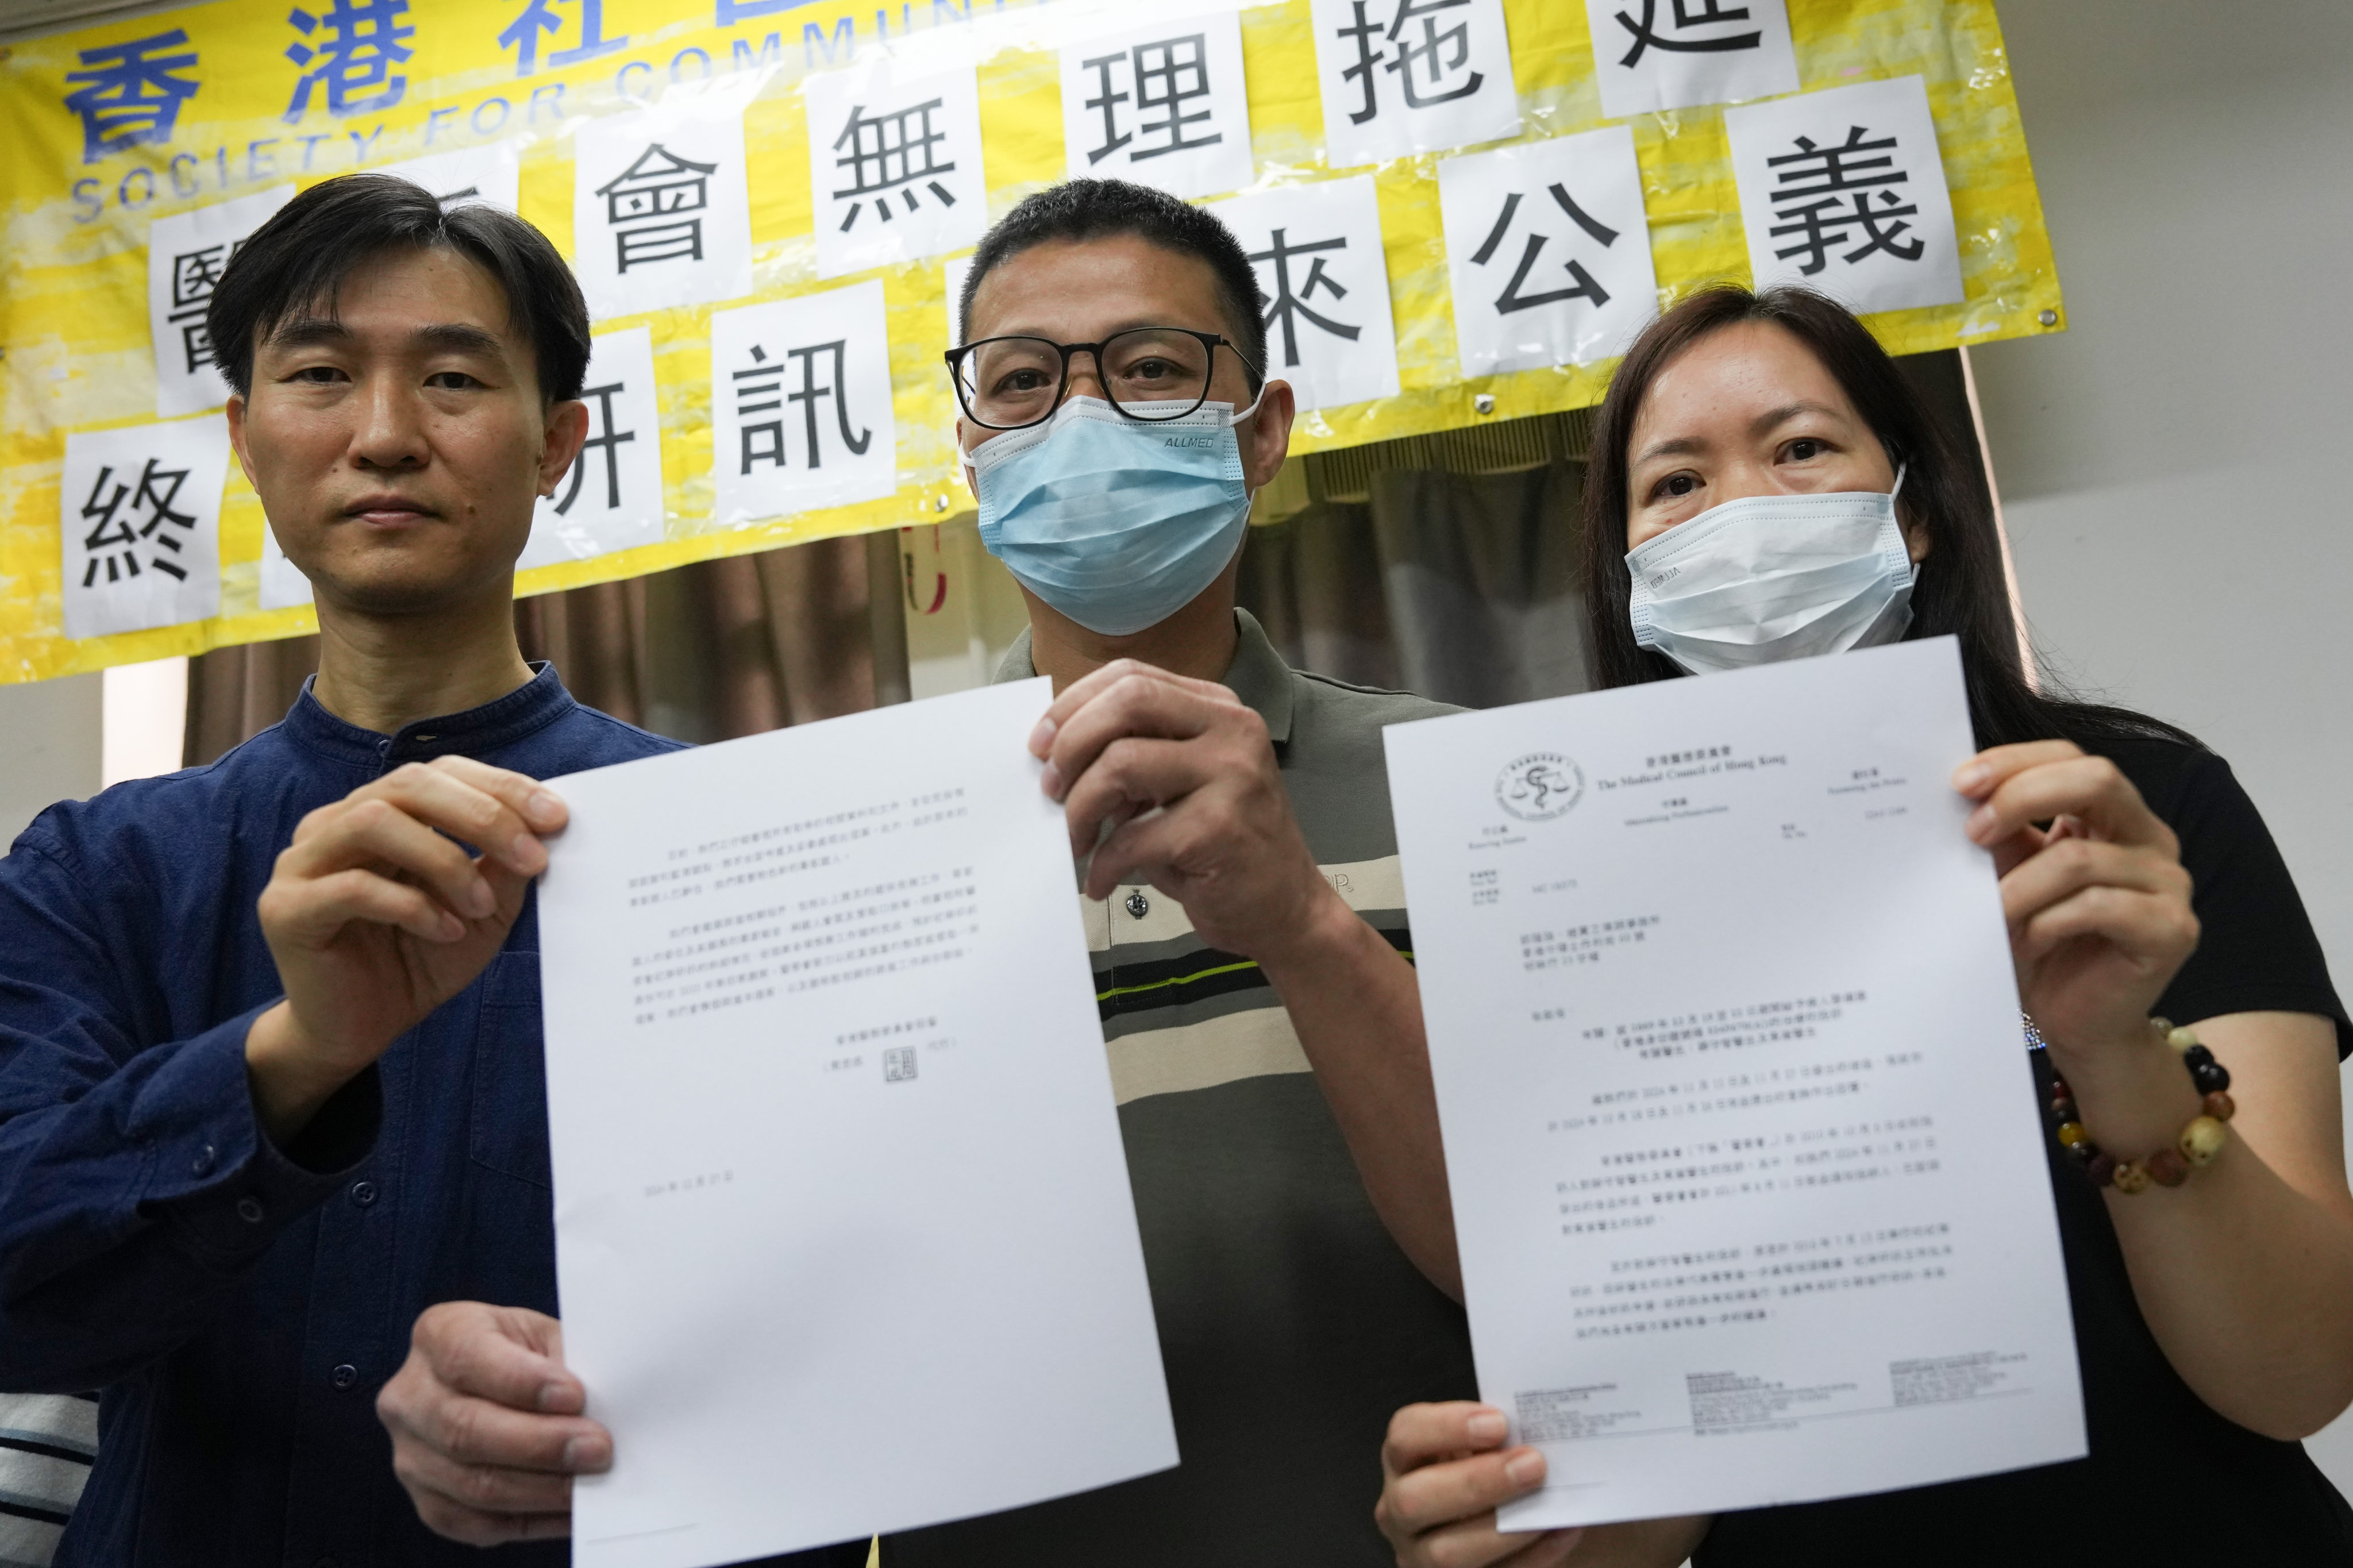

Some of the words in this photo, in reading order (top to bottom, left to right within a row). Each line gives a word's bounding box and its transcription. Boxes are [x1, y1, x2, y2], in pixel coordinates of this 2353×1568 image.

[72, 125, 386, 224] SOCIETY
[424, 83, 565, 146] FOR
[1164, 437, 1214, 448] ALLMED
